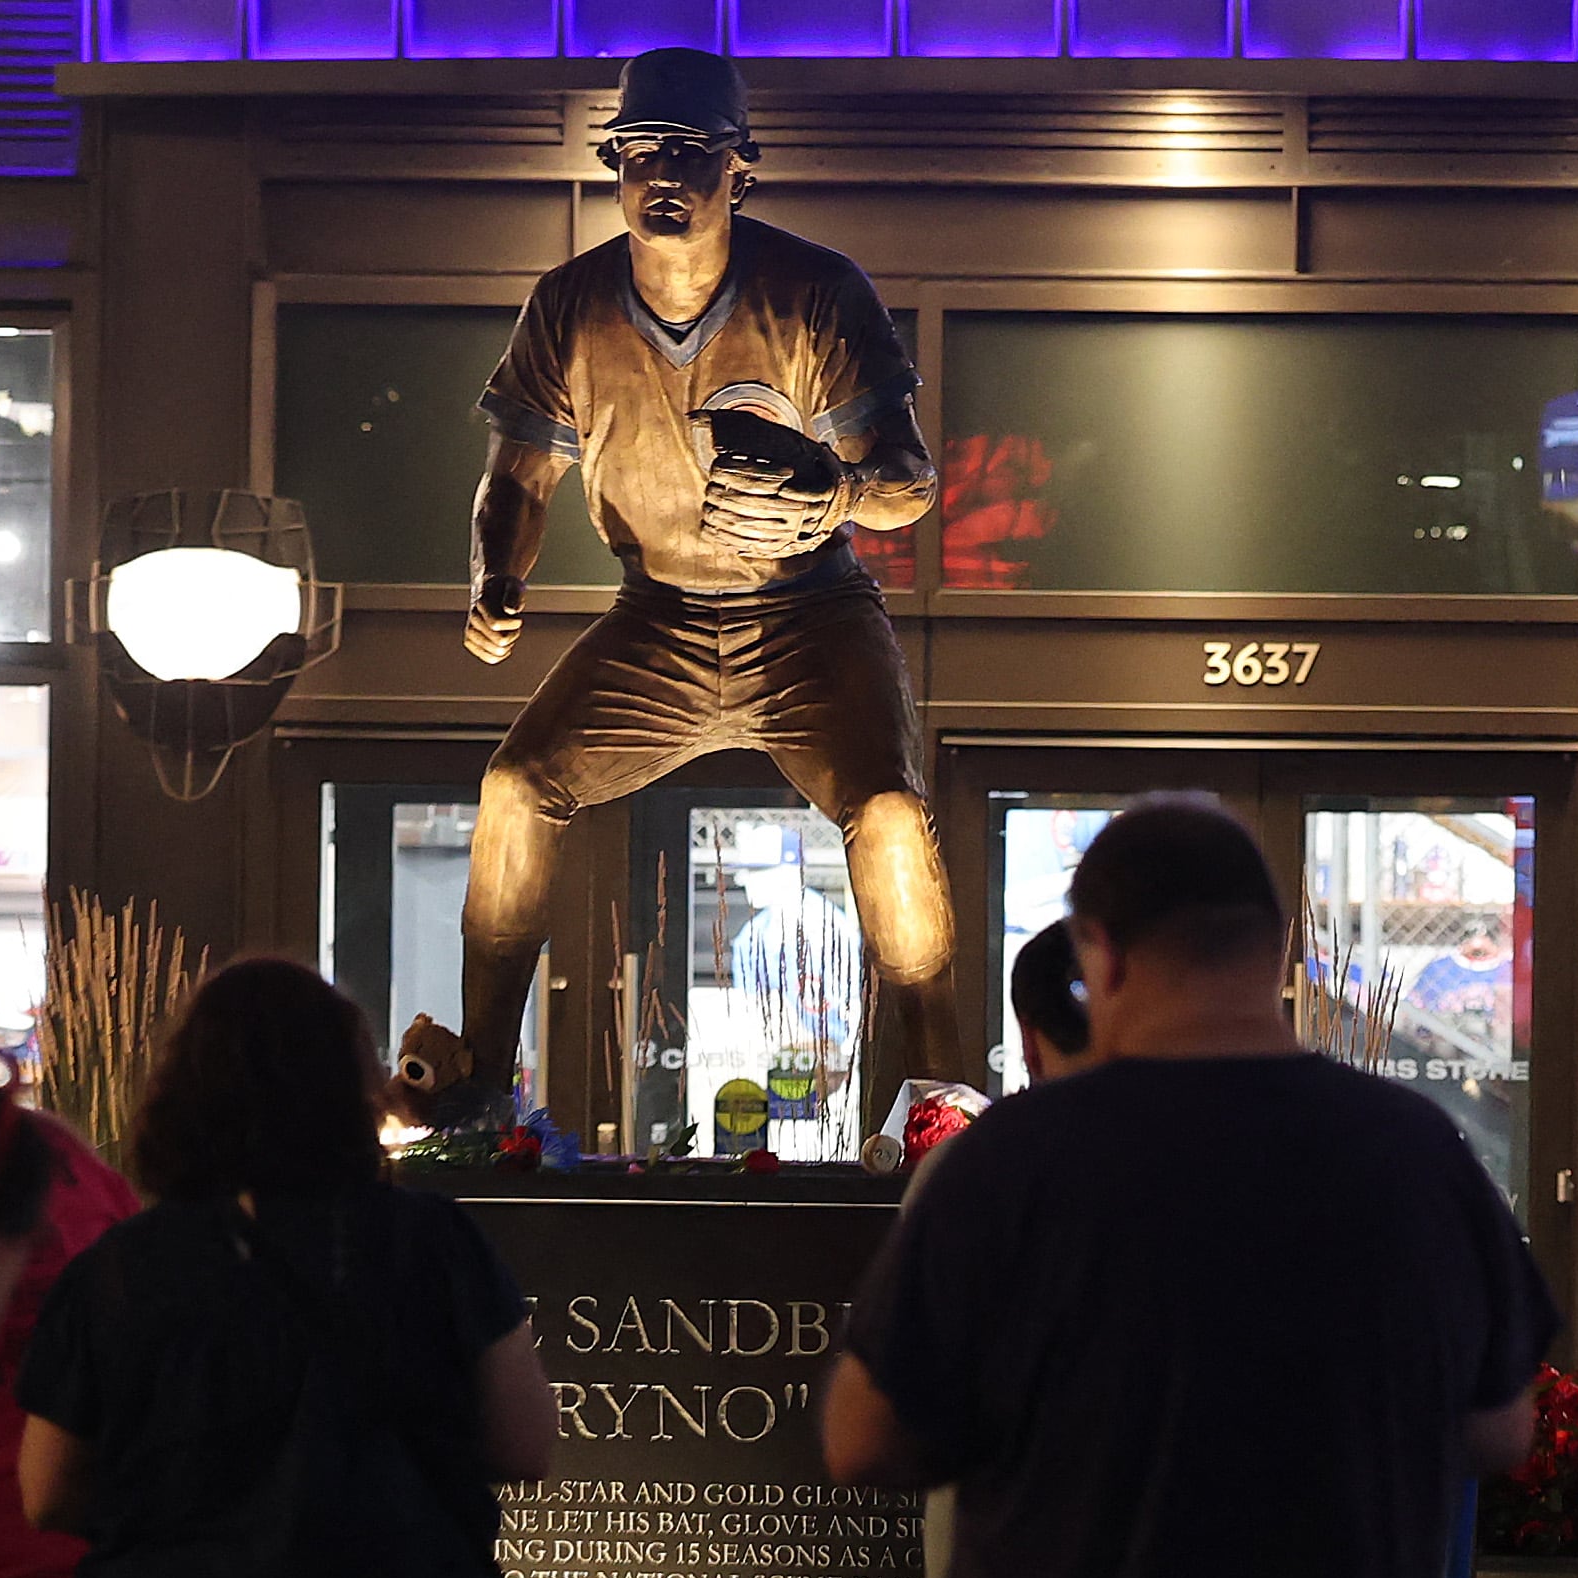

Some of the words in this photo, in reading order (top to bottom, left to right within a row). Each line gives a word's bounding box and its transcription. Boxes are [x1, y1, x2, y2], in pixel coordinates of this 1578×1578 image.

[1203, 642, 1321, 685] 3637
[497, 1480, 628, 1503] ALL-STAR
[634, 1481, 697, 1505] AND
[703, 1483, 785, 1506] GOLD
[792, 1484, 889, 1508] GLOVE
[546, 1510, 599, 1533] LET
[605, 1511, 649, 1534] HIS
[657, 1512, 714, 1539] BAT,
[721, 1513, 819, 1537] GLOVE
[827, 1514, 888, 1538] AND
[553, 1539, 667, 1564] DURING
[676, 1542, 701, 1565] 15
[707, 1543, 831, 1567] SEASONS
[839, 1545, 870, 1567] AS
[879, 1545, 896, 1568] A
